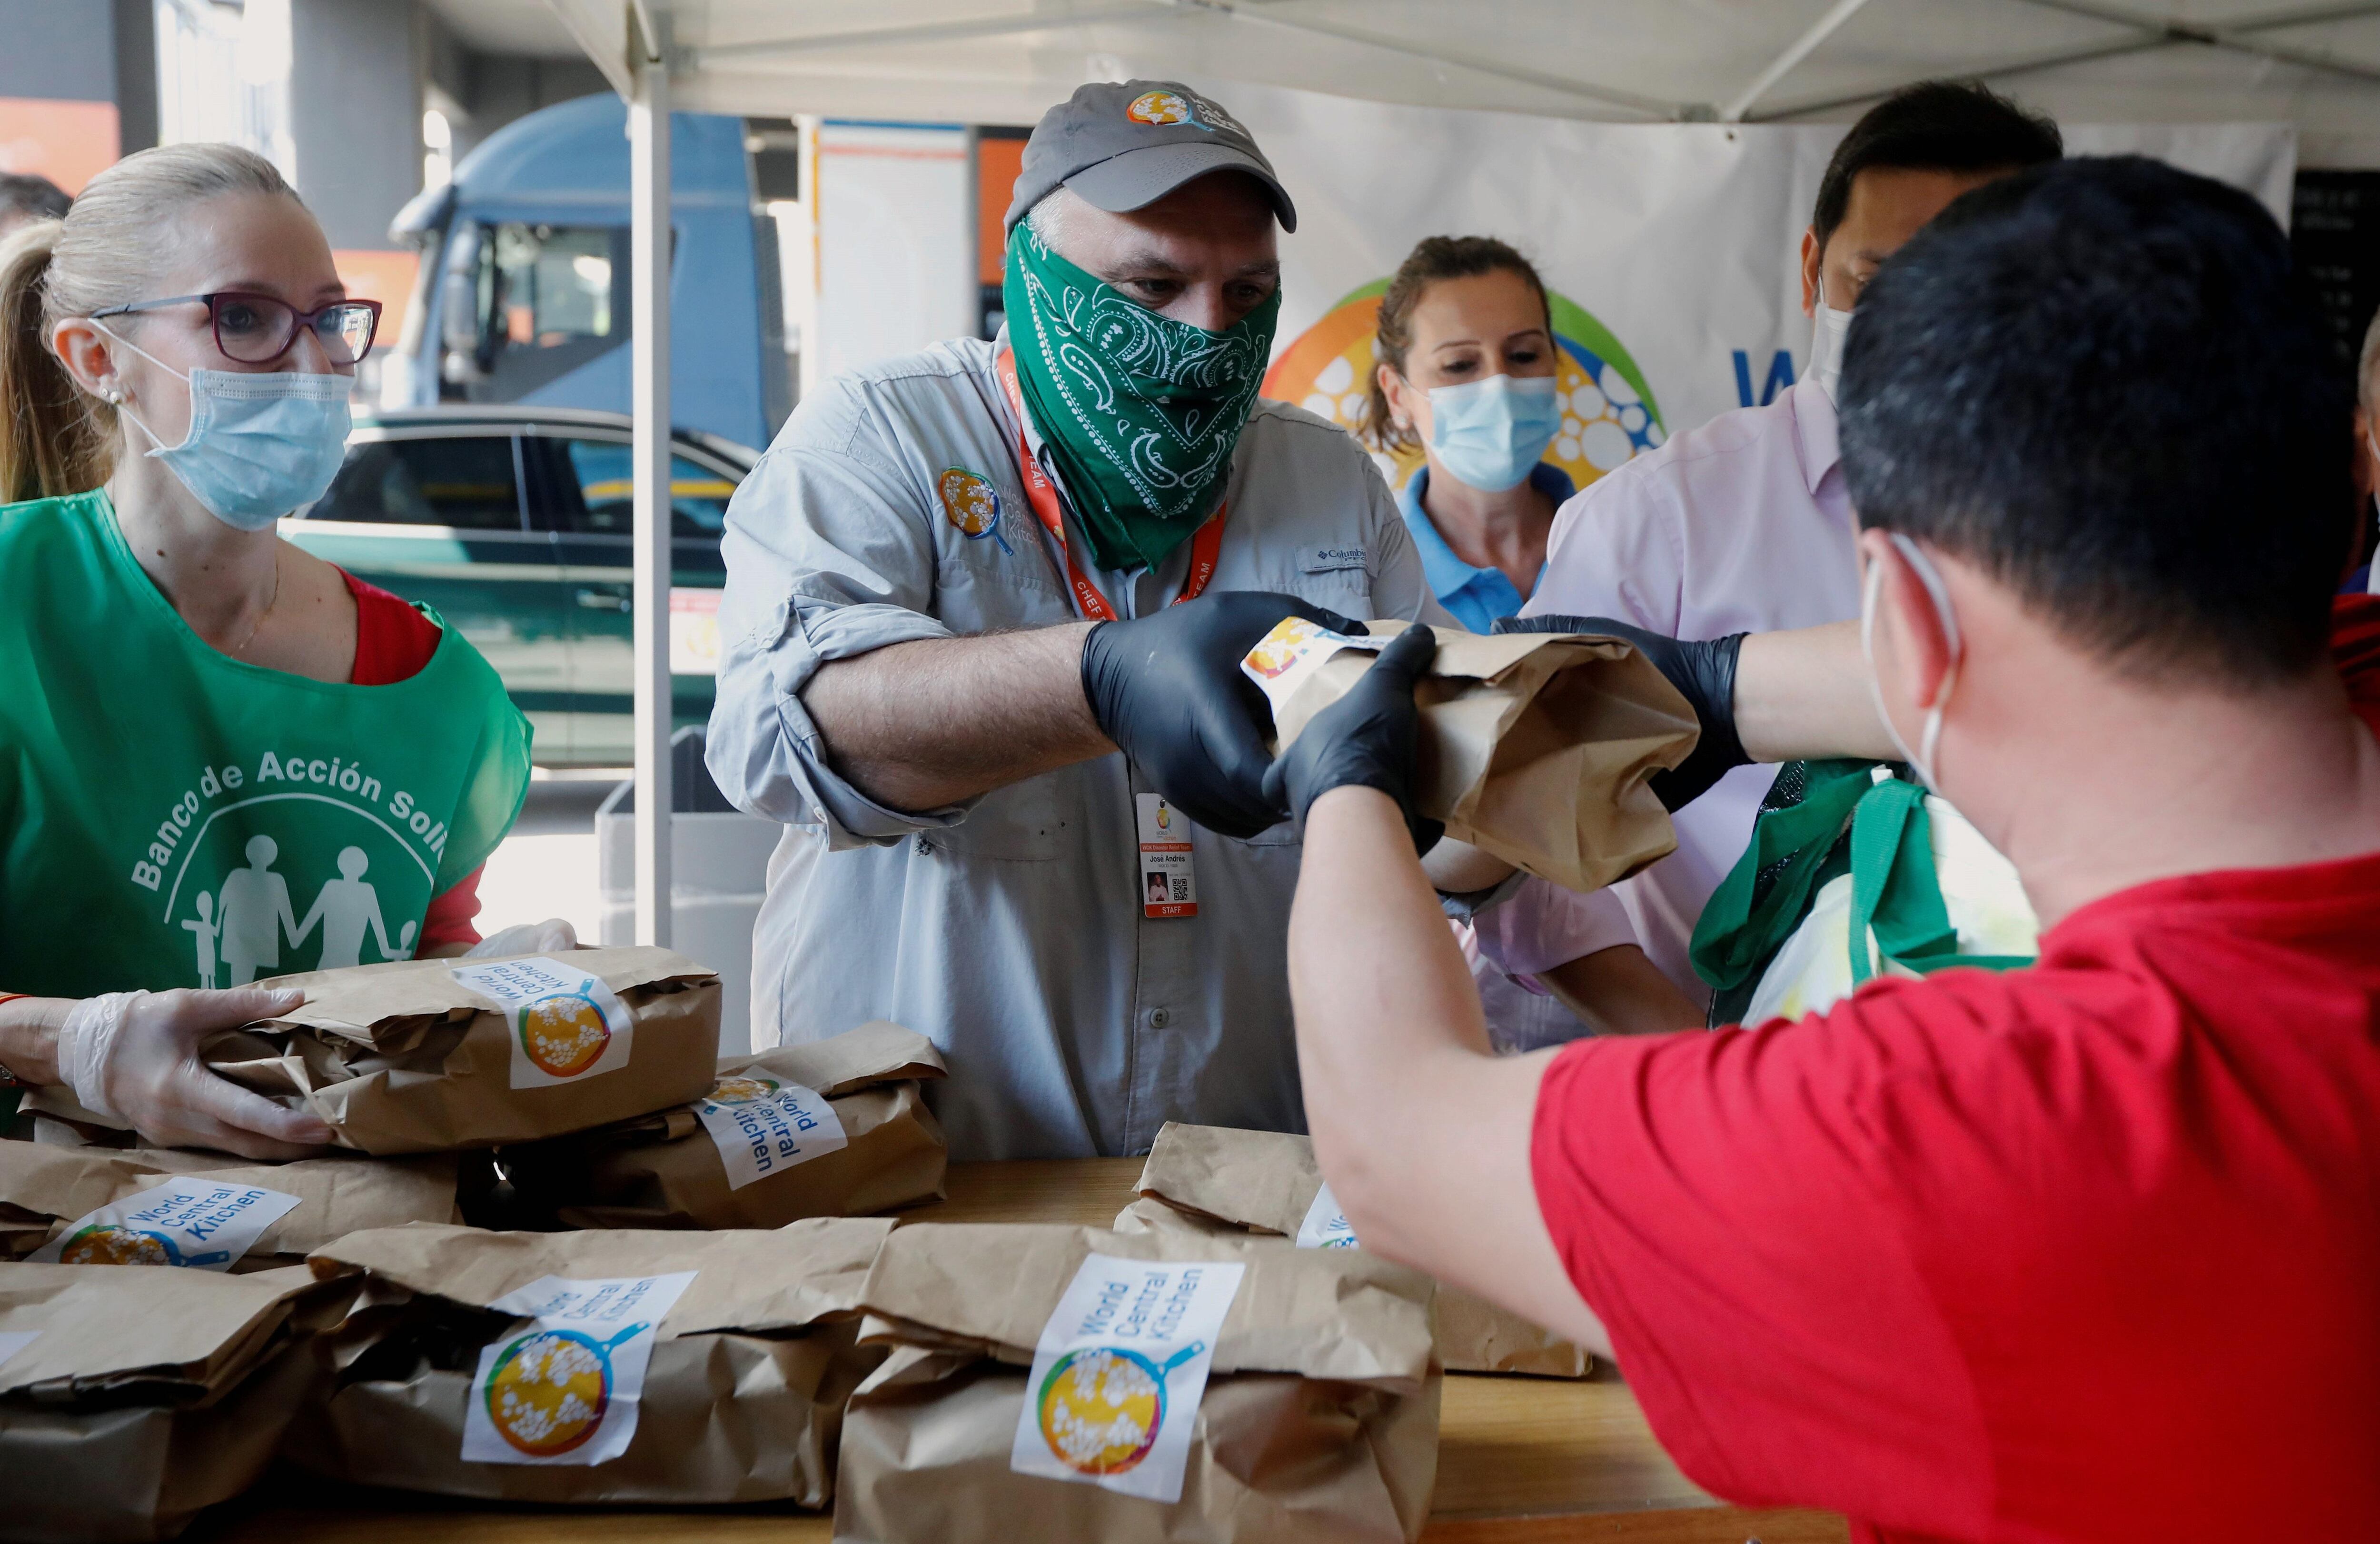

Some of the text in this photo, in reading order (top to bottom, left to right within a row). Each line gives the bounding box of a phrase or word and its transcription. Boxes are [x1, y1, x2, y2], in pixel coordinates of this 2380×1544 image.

[999, 484, 1023, 506] Wor
[1077, 582, 1102, 614] CHEF
[131, 751, 447, 891] Banco de Acción Soli
[1165, 854, 1185, 862] Andrés
[473, 975, 523, 1000] World
[484, 966, 545, 995] Central
[510, 961, 569, 988] Kitchen
[775, 1094, 818, 1131] World
[128, 1194, 195, 1223] World
[160, 1188, 237, 1227] Central
[186, 1190, 266, 1241] Kitchen
[1078, 1281, 1130, 1336] World
[1114, 1271, 1170, 1338] Central
[1146, 1268, 1203, 1341] Kitchen
